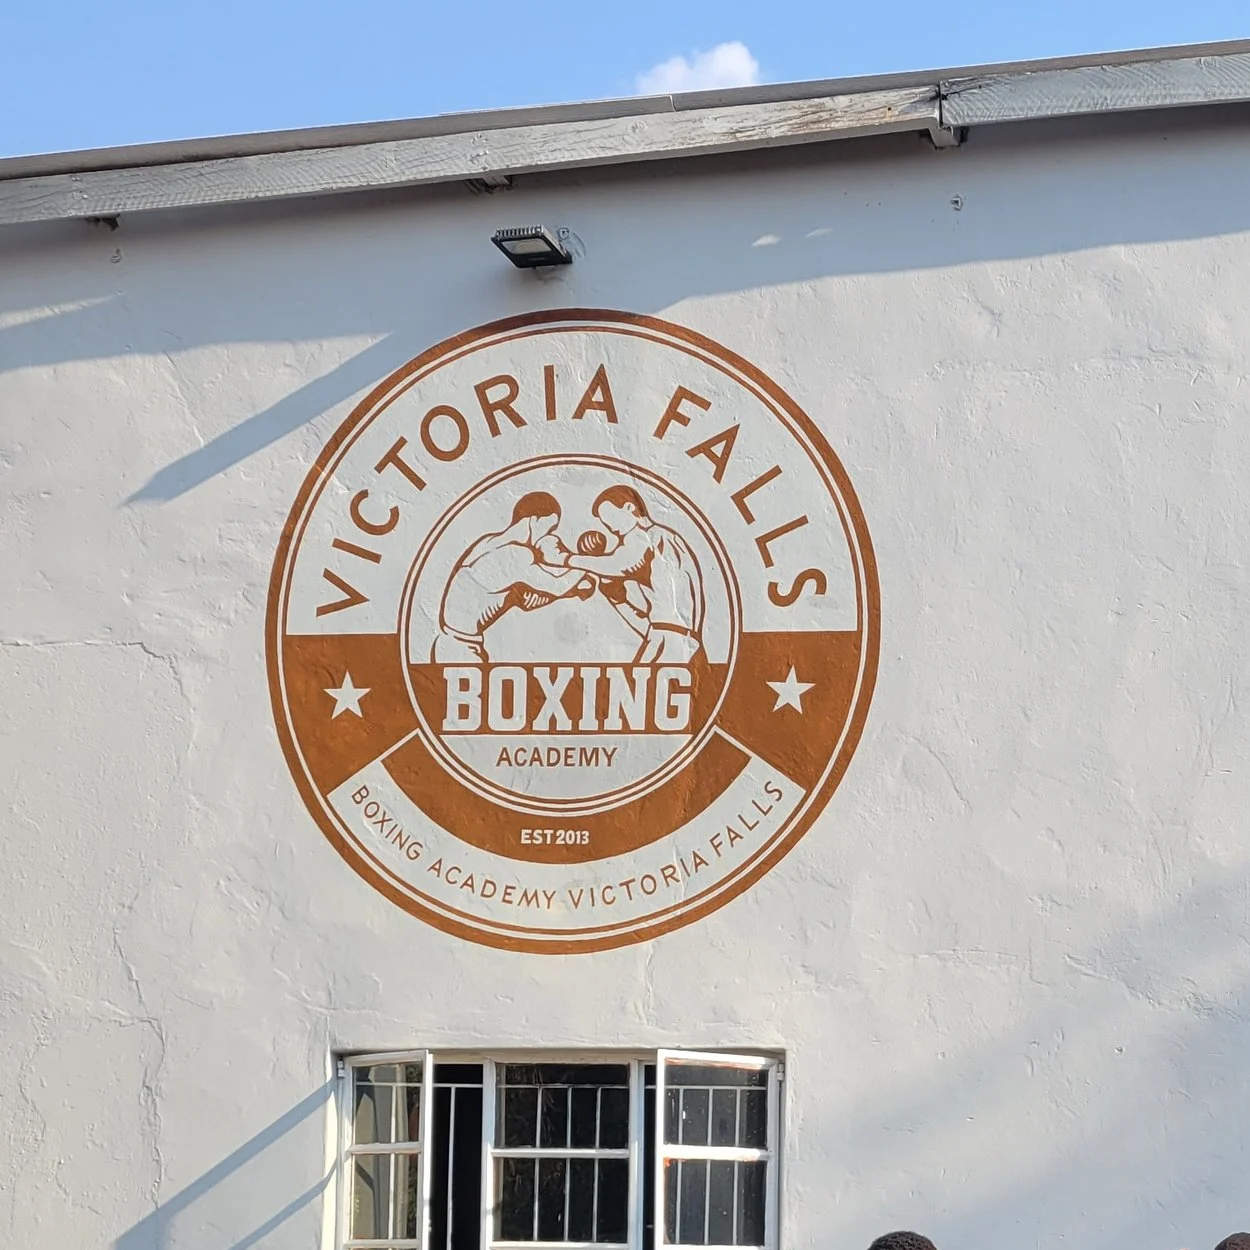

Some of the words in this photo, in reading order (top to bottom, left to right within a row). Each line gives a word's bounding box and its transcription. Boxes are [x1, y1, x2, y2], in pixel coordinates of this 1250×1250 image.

[315, 362, 620, 618] VICTORIA
[652, 384, 828, 608] FALLS
[442, 666, 692, 732] BOXING
[495, 747, 618, 767] ACADEMY
[351, 784, 423, 861] BOXING
[427, 857, 557, 910] ACADEMY
[568, 850, 710, 909] VICTORIA
[708, 780, 785, 858] FALLS
[520, 829, 554, 845] EST
[555, 829, 590, 845] 2013
